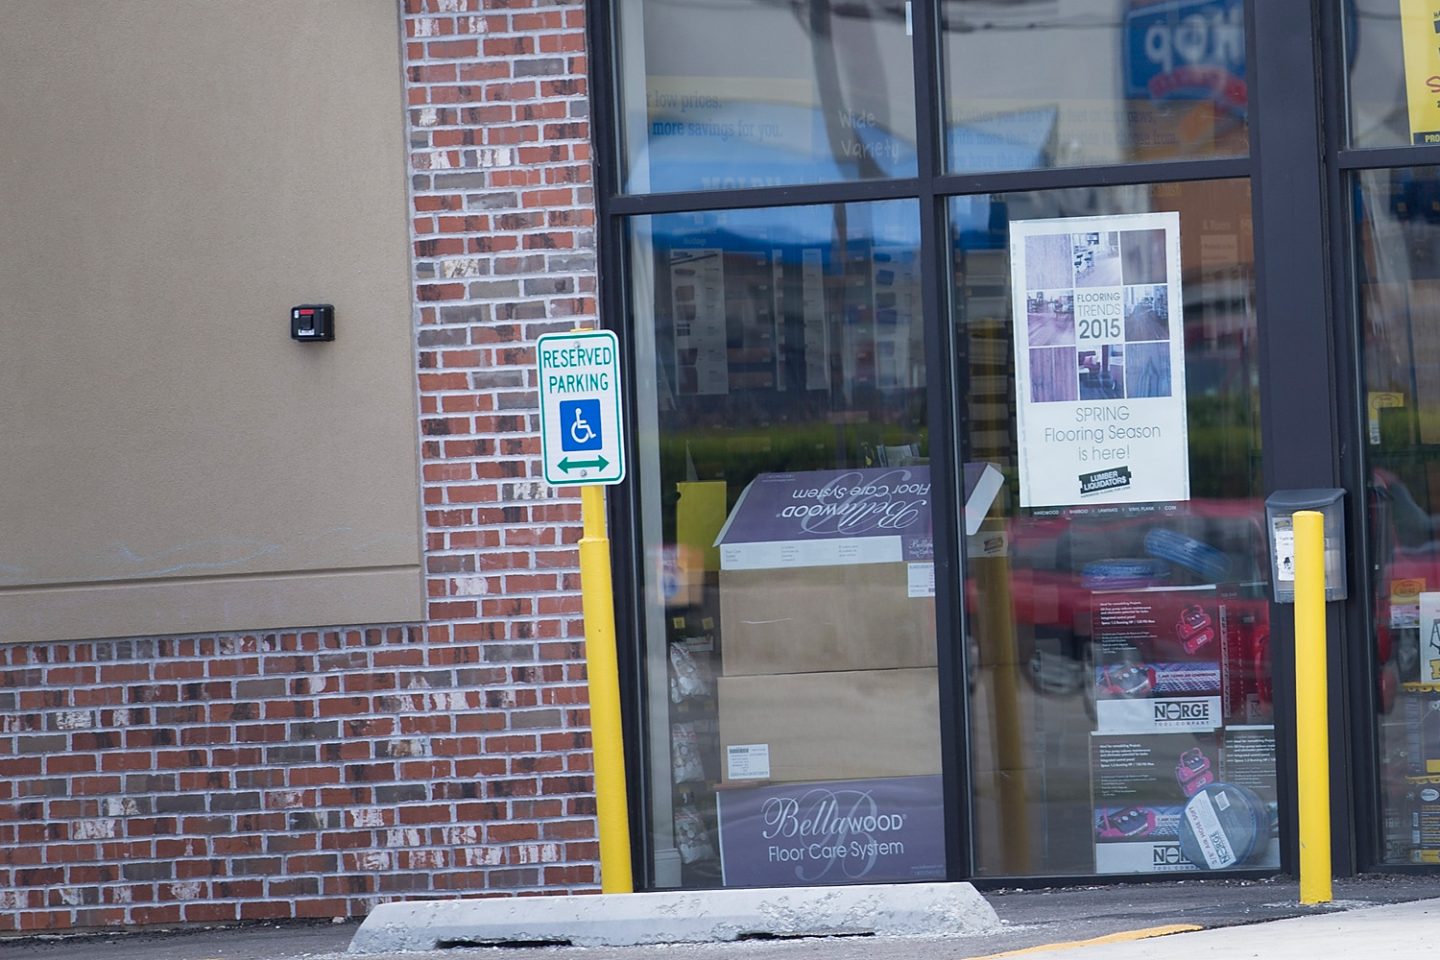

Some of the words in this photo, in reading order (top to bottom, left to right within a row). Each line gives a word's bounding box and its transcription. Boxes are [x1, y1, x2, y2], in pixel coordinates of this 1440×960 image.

[1077, 292, 1120, 302] FLOORING
[1077, 303, 1121, 317] TRENDS
[1079, 318, 1121, 339] 2015
[543, 347, 612, 368] RESERVED
[549, 372, 609, 393] PARKING
[1075, 405, 1130, 422] SPRING
[1044, 426, 1104, 443] Flooring
[1108, 425, 1161, 440] Season
[1078, 446, 1088, 461] is
[1092, 445, 1130, 461] here!
[1090, 470, 1119, 483] LUMBER
[792, 485, 847, 499] System
[849, 485, 889, 497] Care
[1154, 702, 1209, 720] NORGE
[768, 845, 805, 862] Floor
[808, 844, 847, 860] Care
[850, 841, 904, 861] System
